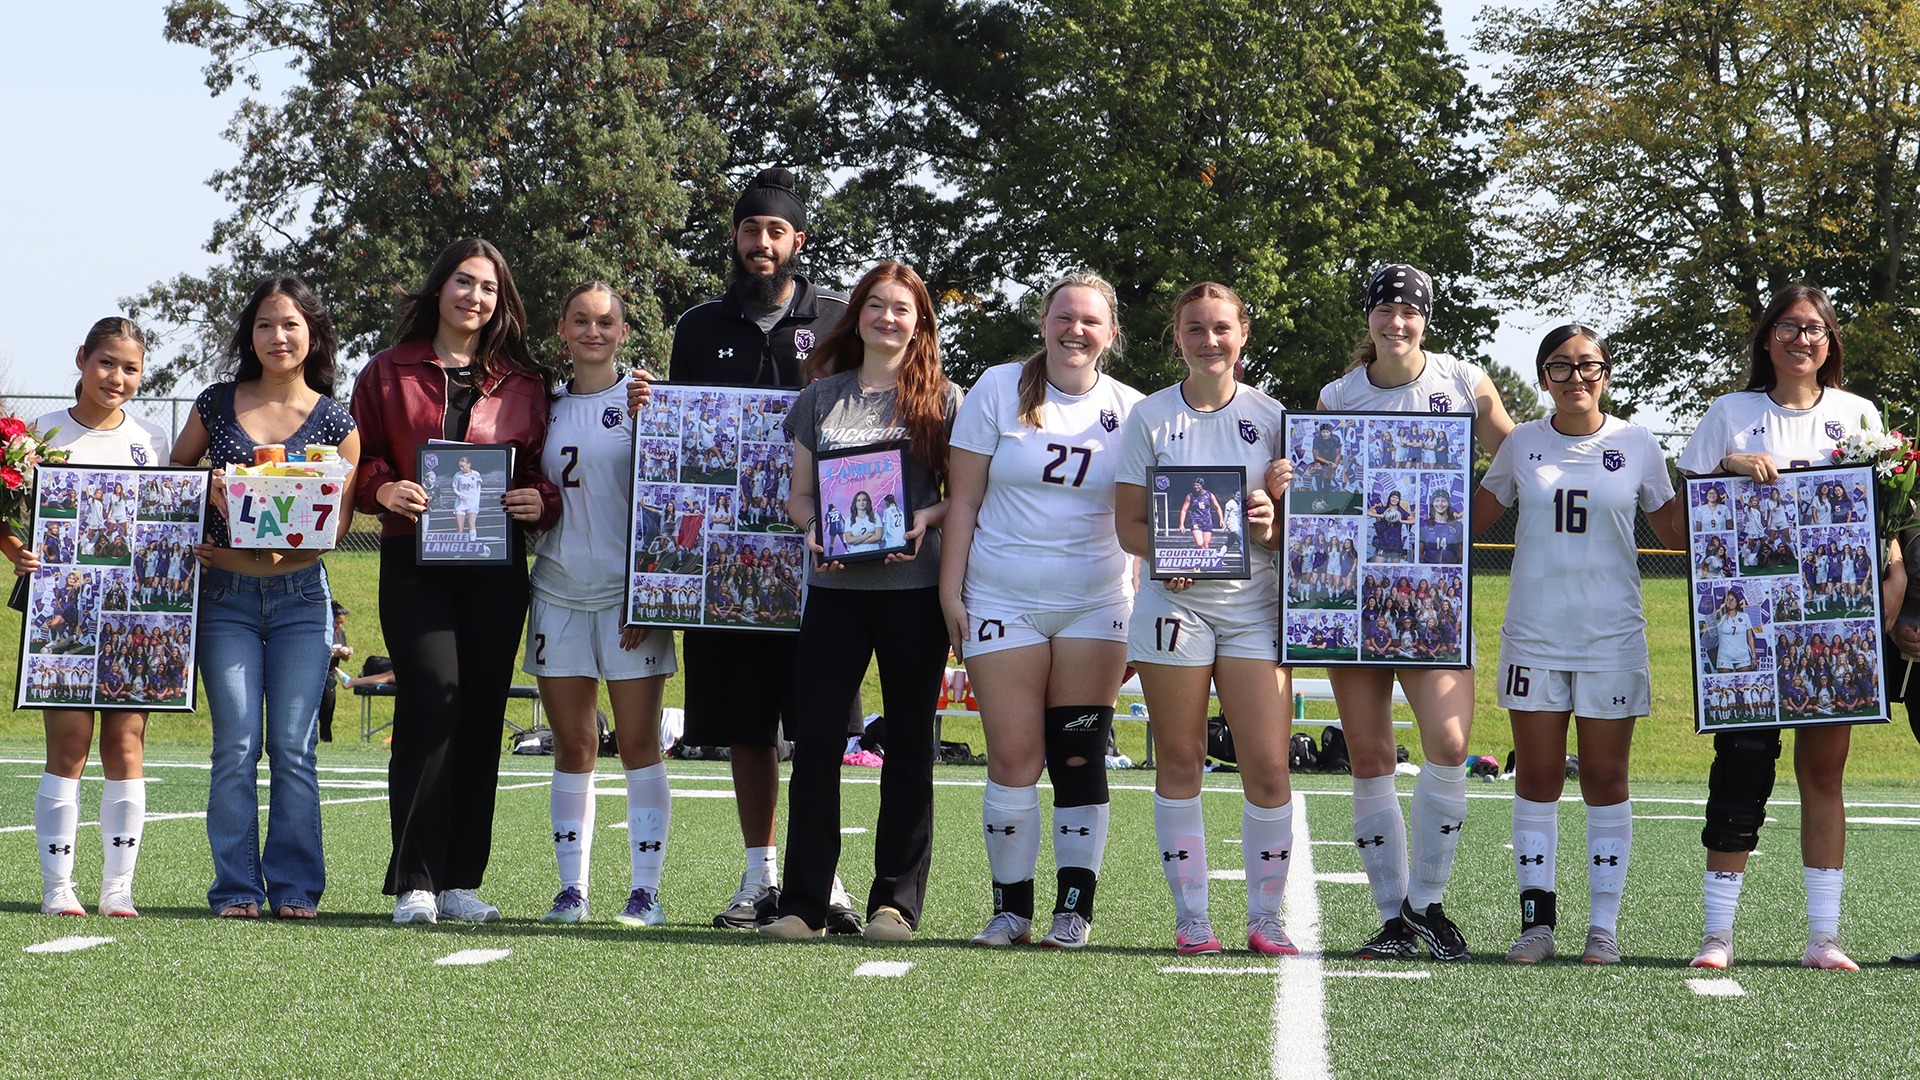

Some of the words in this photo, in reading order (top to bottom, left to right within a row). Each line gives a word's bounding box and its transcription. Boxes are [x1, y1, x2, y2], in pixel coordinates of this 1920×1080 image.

[560, 446, 581, 488] 2
[1042, 443, 1092, 488] 27
[239, 494, 296, 539] LAY
[829, 513, 840, 522] 22
[1553, 488, 1589, 534] 16
[1711, 519, 1717, 528] 9
[425, 533, 468, 542] CAMILLE
[1436, 537, 1448, 550] 14
[425, 542, 482, 552] LANGLET
[1160, 549, 1214, 557] COURTNEY
[1159, 558, 1221, 568] MURPHY
[1154, 616, 1181, 652] 17
[1731, 626, 1737, 636] 7
[535, 633, 546, 666] 2
[1506, 664, 1531, 698] 16
